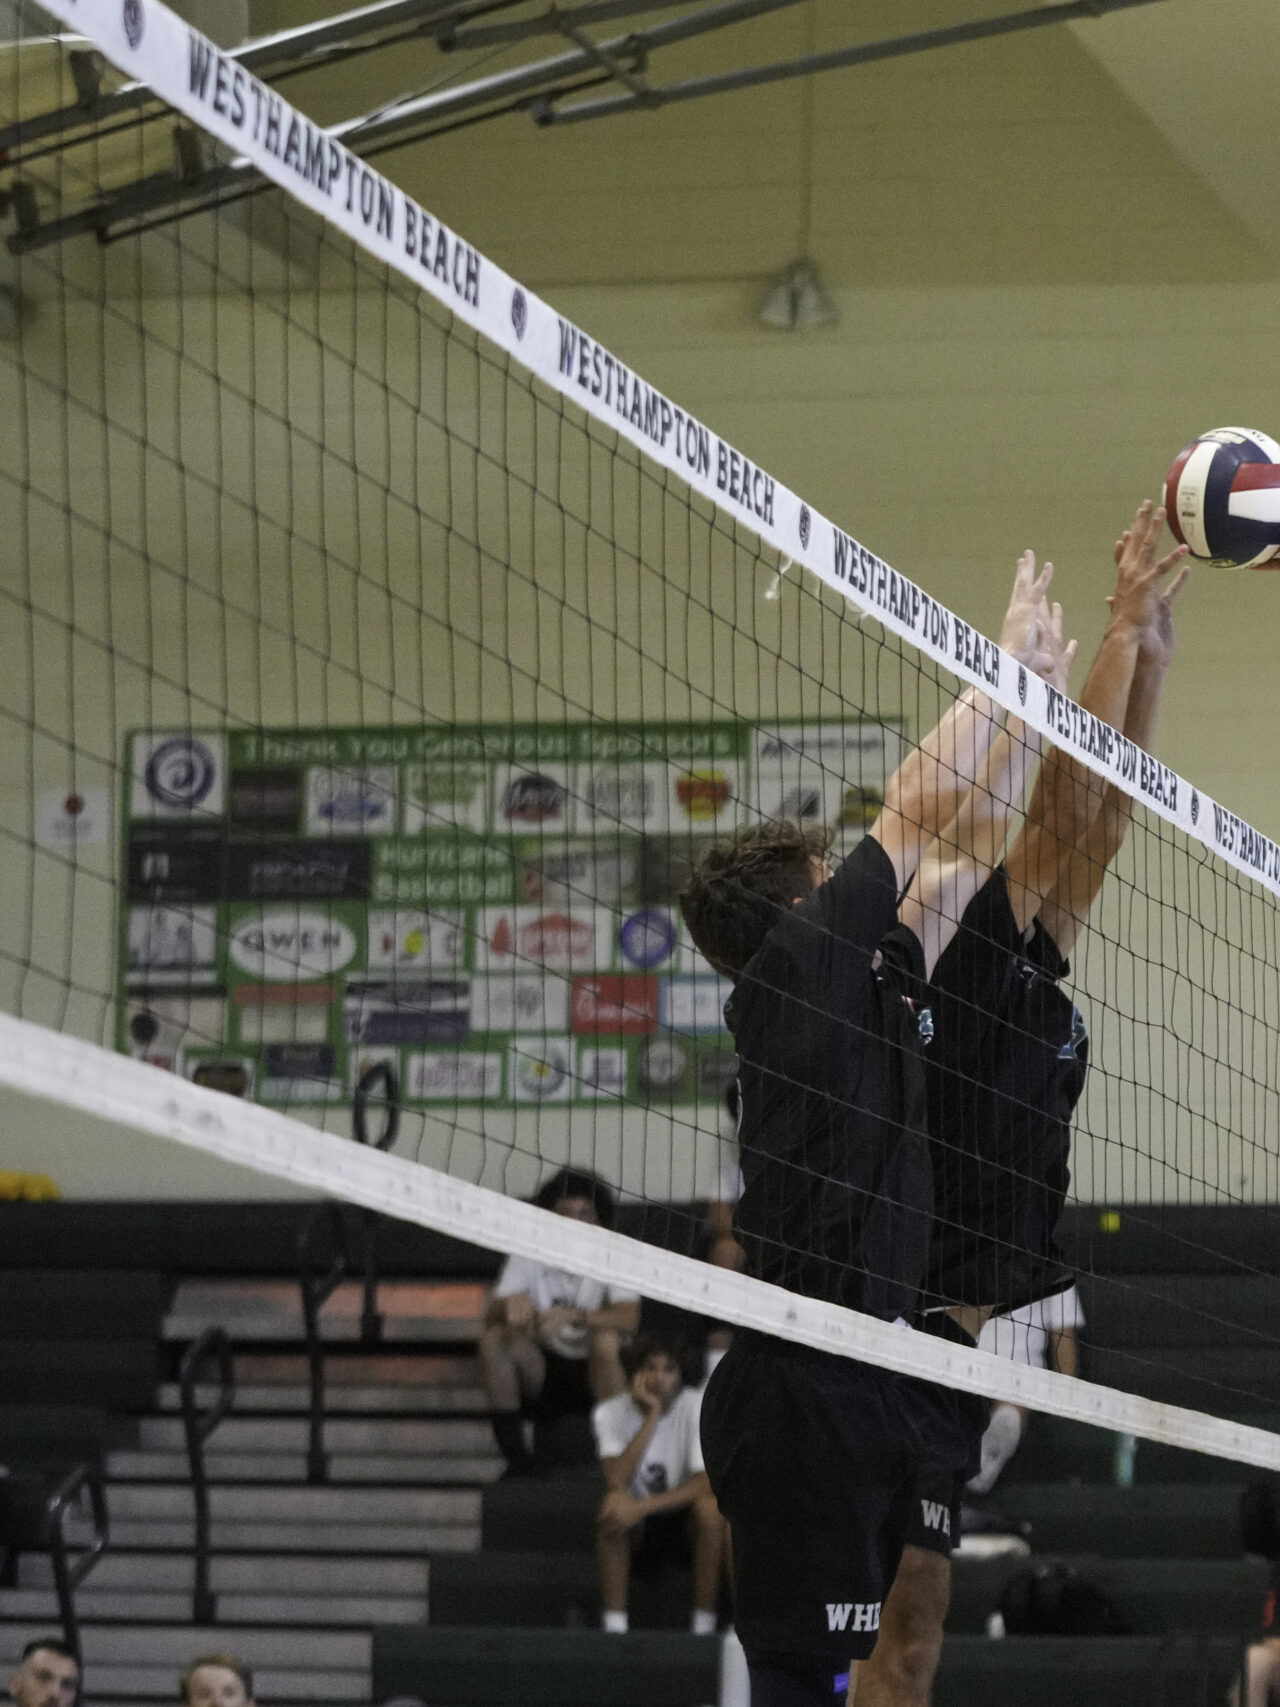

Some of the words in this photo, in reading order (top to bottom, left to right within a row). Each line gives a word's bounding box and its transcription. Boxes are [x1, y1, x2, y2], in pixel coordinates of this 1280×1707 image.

[189, 30, 396, 243] WESTHAMPTON
[405, 199, 482, 308] BEACH
[558, 318, 711, 479] WESTHAMPTON
[716, 440, 776, 527] BEACH
[833, 526, 949, 654] WESTHAMPTON
[953, 616, 1000, 689] BEACH
[1045, 683, 1137, 784] WESTHAMPTON
[1140, 750, 1178, 812] BEACH
